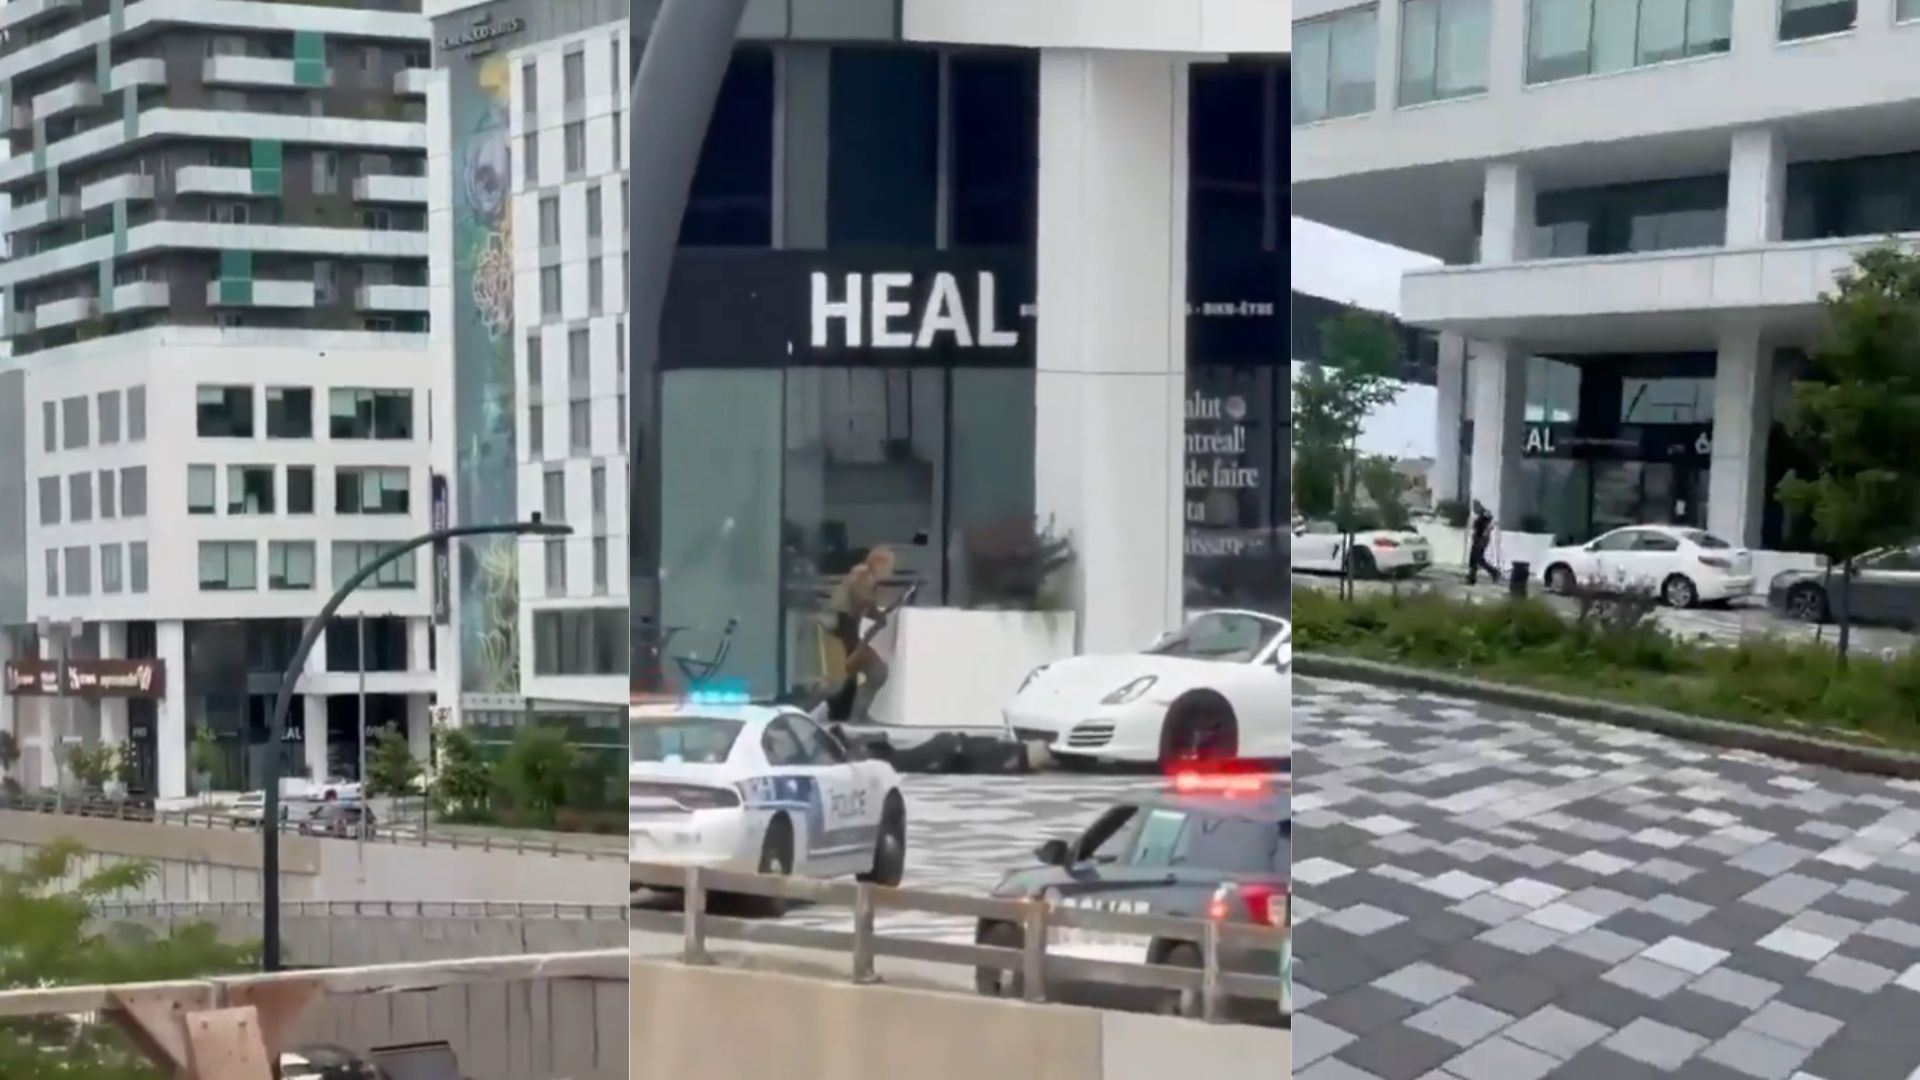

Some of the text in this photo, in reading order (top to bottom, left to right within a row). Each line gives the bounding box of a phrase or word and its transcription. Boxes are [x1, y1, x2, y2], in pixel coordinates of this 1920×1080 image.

[811, 271, 1019, 347] HEAL
[1521, 427, 1555, 452] AL
[1213, 458, 1258, 488] faire
